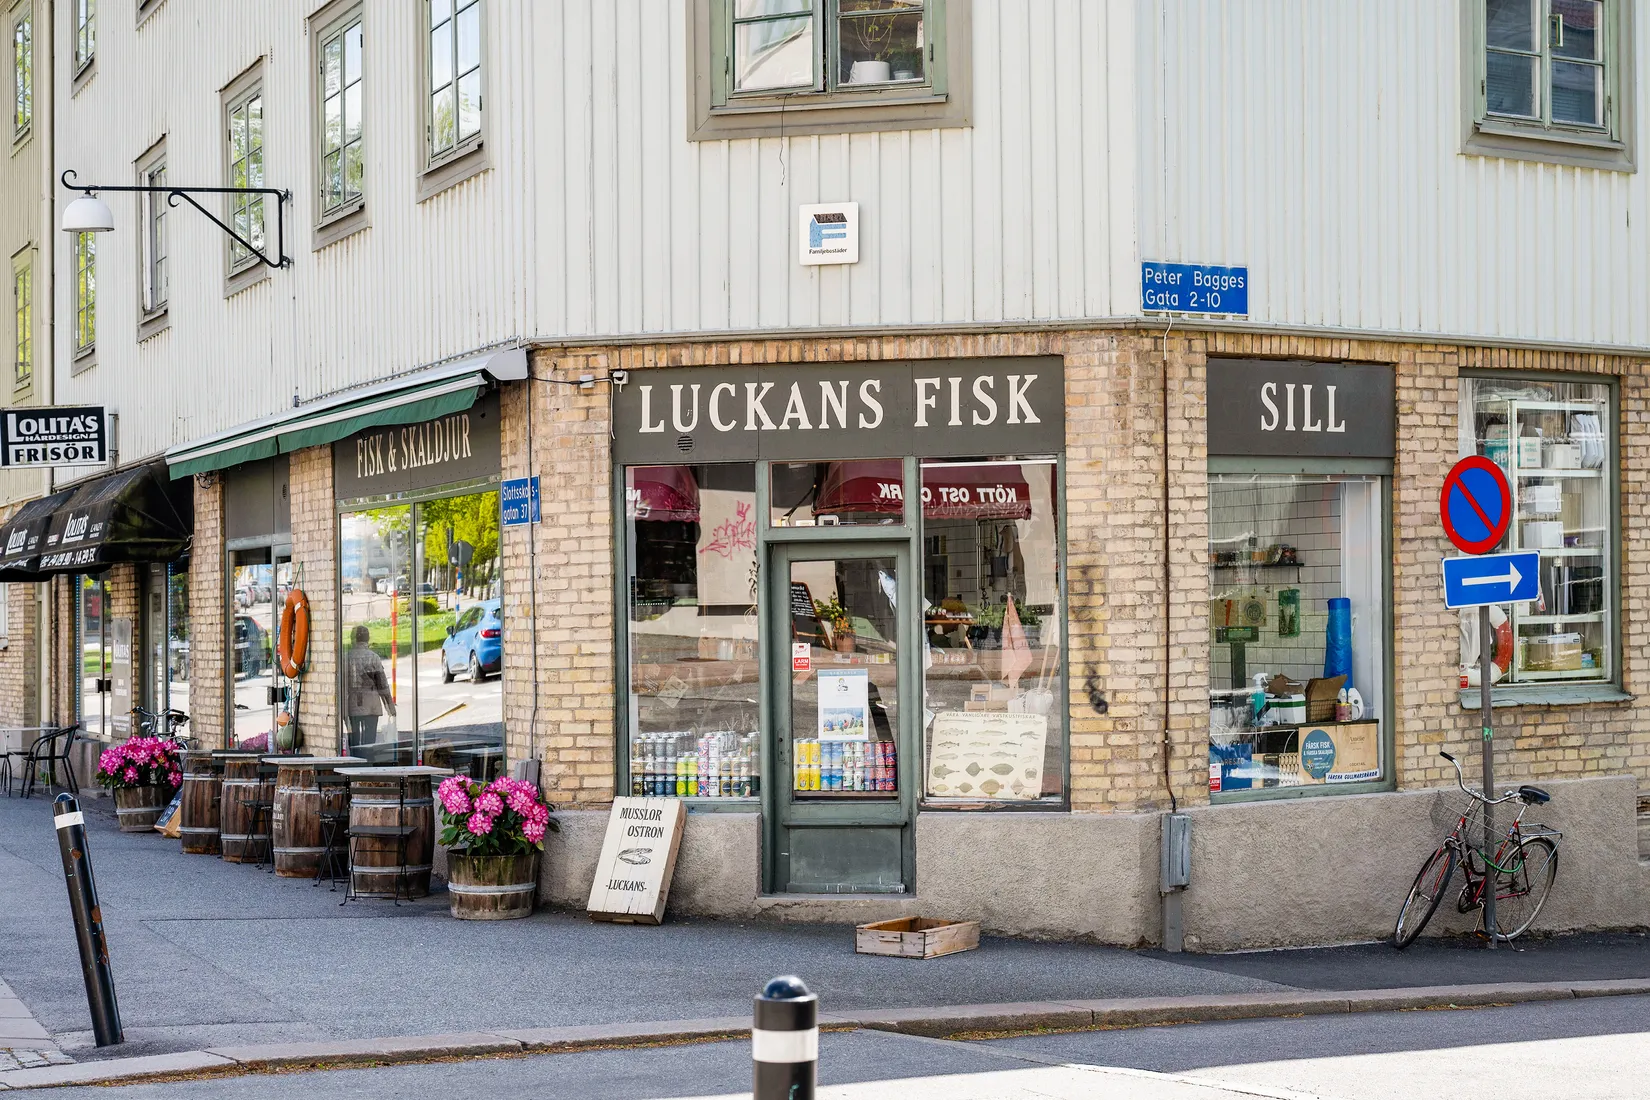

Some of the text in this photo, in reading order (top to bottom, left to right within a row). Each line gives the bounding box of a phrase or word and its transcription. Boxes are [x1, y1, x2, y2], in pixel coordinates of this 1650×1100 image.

[1145, 268, 1245, 291] Peter Bagges
[1146, 290, 1221, 308] Gata 2-10
[638, 374, 1041, 433] LUCKANS FISK
[1261, 382, 1346, 432] SILL
[7, 413, 99, 443] LOLITA'S
[14, 443, 95, 463] FRISÖR
[357, 413, 472, 479] FISK & SKALDJUR
[503, 484, 538, 501] Slottsskos-
[503, 503, 528, 524] gatan 37
[1320, 741, 1331, 749] FISK
[619, 807, 663, 821] MUSSLOR
[627, 825, 665, 838] OSTRON
